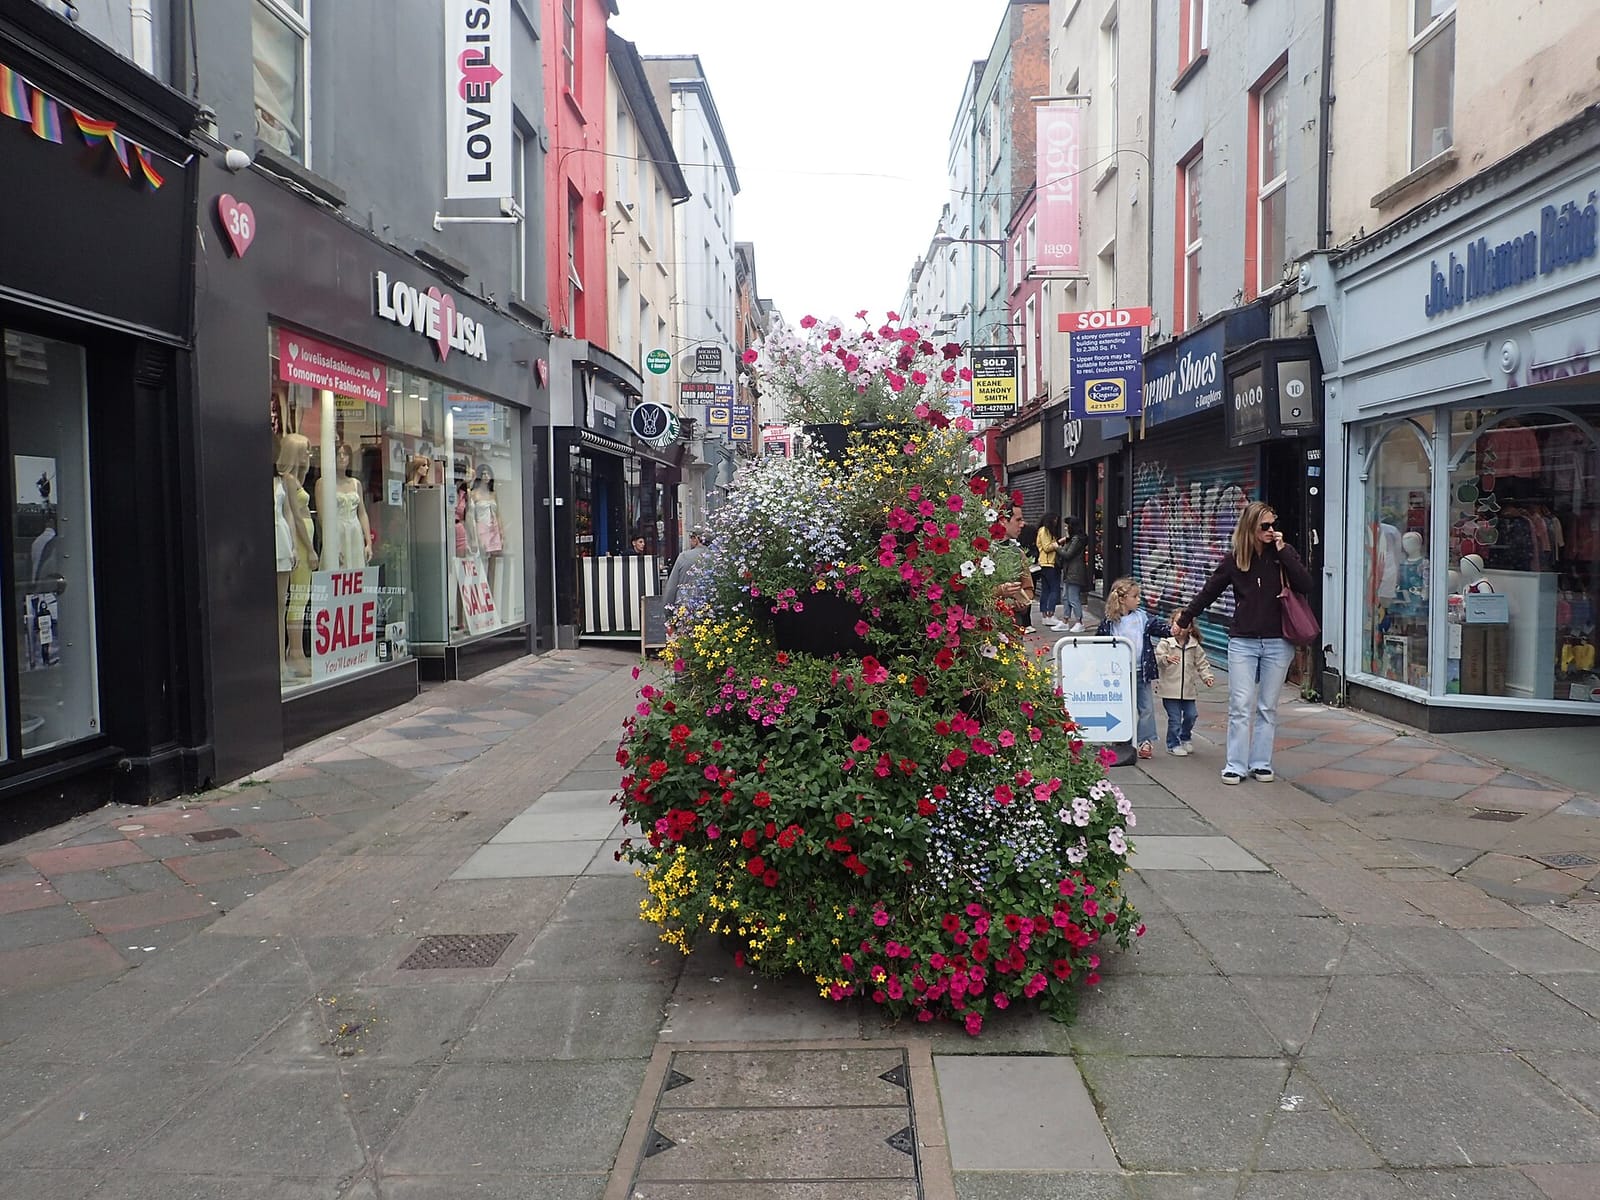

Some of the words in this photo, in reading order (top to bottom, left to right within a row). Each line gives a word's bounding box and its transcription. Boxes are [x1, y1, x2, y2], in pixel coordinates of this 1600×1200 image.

[465, 0, 491, 66] LIS
[230, 208, 250, 238] 36
[1425, 252, 1465, 318] JoJo
[1466, 230, 1537, 302] Maman
[377, 270, 441, 341] LOVE
[446, 306, 488, 362] LISA
[1078, 310, 1130, 329] SOLD
[1076, 340, 1098, 348] building
[1099, 337, 1126, 346] extending
[1082, 334, 1098, 342] storey
[1098, 331, 1130, 339] commercial
[301, 348, 370, 380] lovelisafashion.com
[1096, 366, 1118, 374] (subject
[1178, 350, 1216, 395] Shoes
[287, 362, 333, 388] Tomorrow's
[334, 377, 360, 394] Fashion
[362, 384, 381, 402] Today
[1291, 384, 1301, 395] 10
[462, 560, 477, 576] THE
[331, 572, 363, 597] THE
[462, 582, 494, 616] SALE
[315, 601, 374, 656] SALE
[343, 654, 358, 669] Love
[1072, 692, 1086, 702] JoJo
[1087, 691, 1108, 701] Maman
